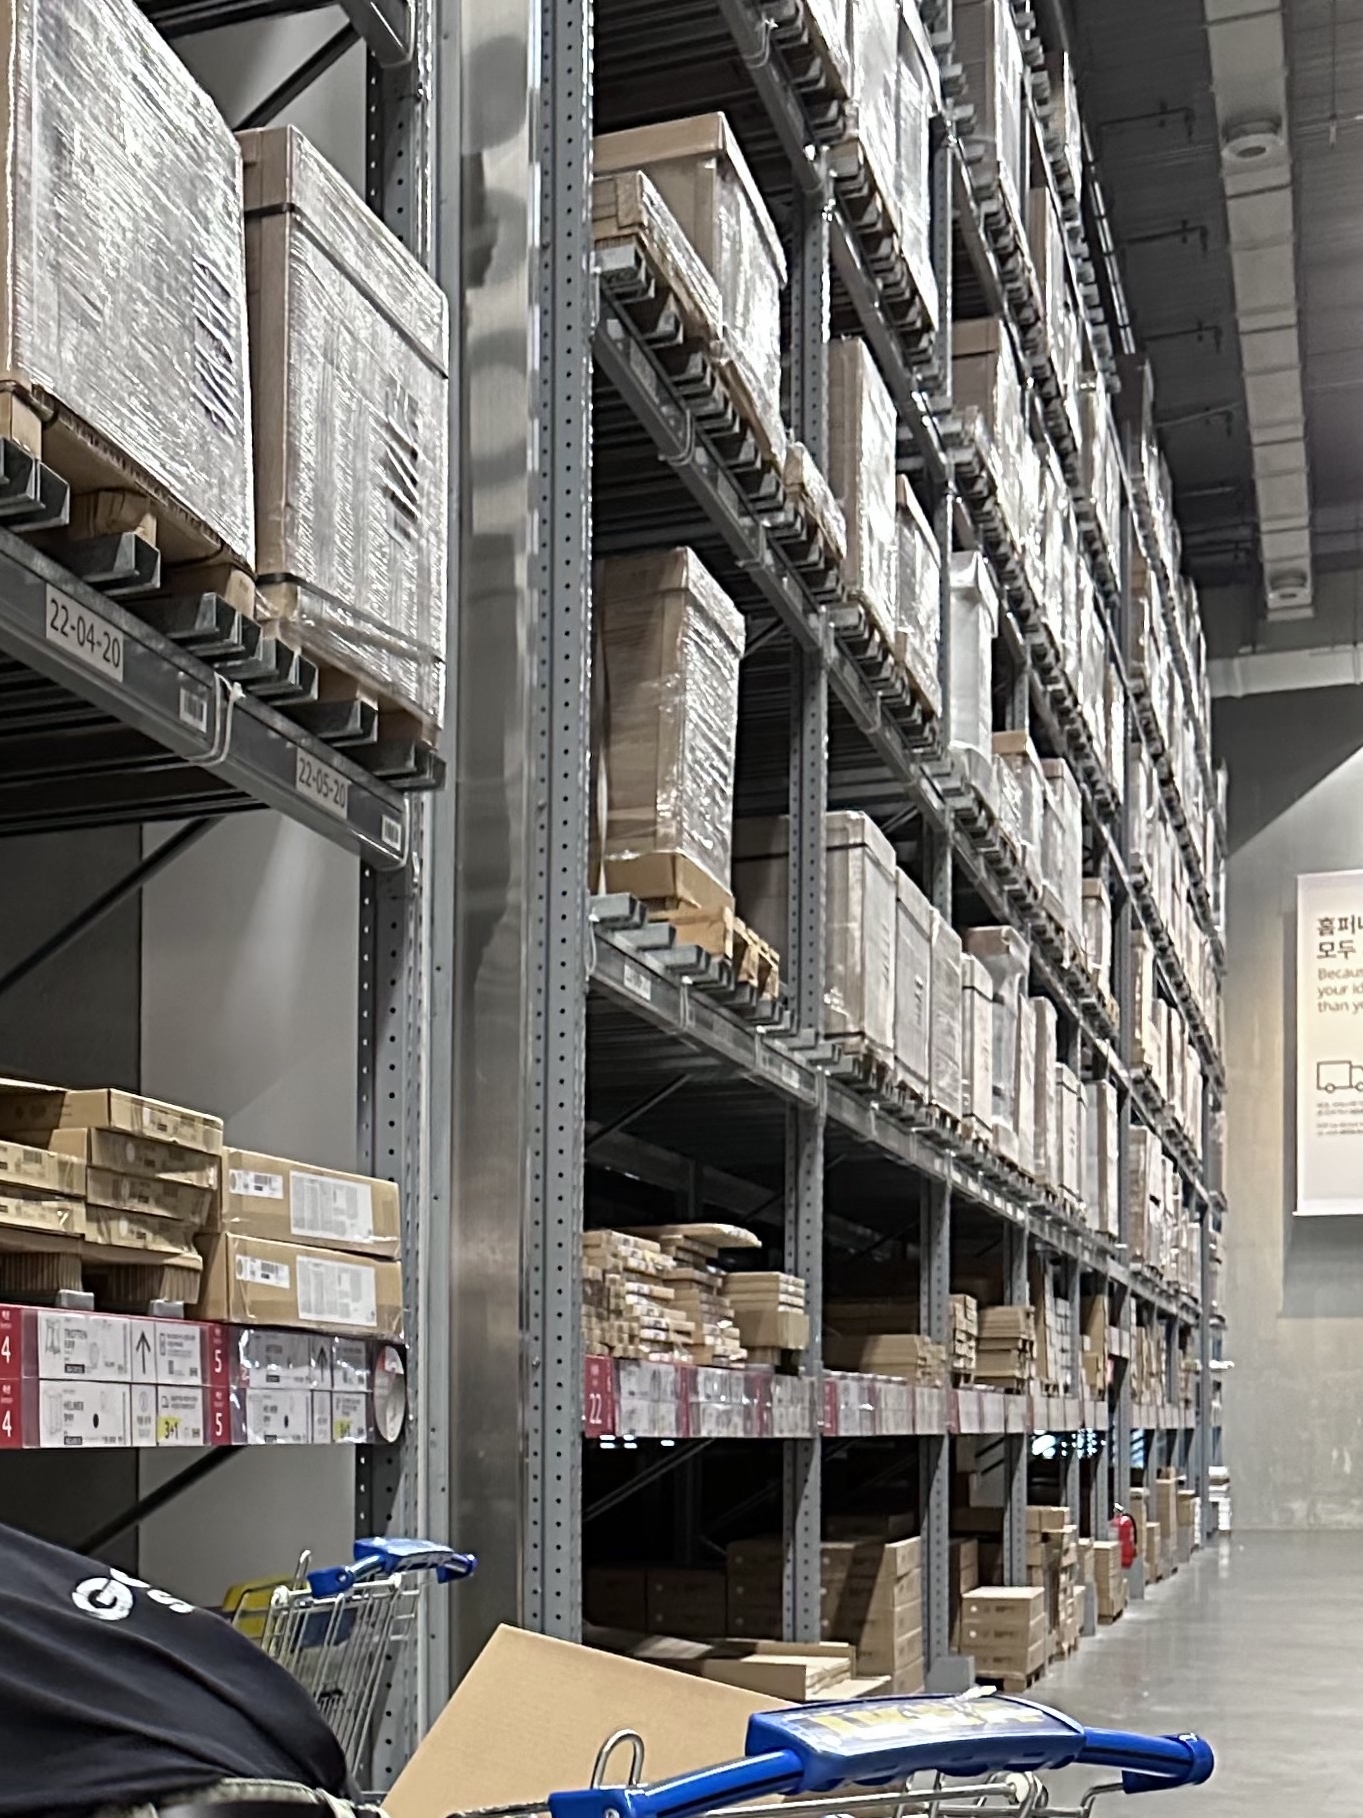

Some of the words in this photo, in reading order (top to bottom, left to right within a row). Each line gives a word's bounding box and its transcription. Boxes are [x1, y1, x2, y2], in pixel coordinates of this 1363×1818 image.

[50, 598, 120, 668] 22-04-20
[298, 758, 346, 809] 22-05-20
[1317, 940, 1356, 960] 모두
[1317, 985, 1348, 999] your
[1318, 1001, 1348, 1013] than
[1, 1335, 11, 1364] 4
[214, 1349, 222, 1373] 5
[2, 1410, 12, 1437] 4
[216, 1412, 223, 1436] 5
